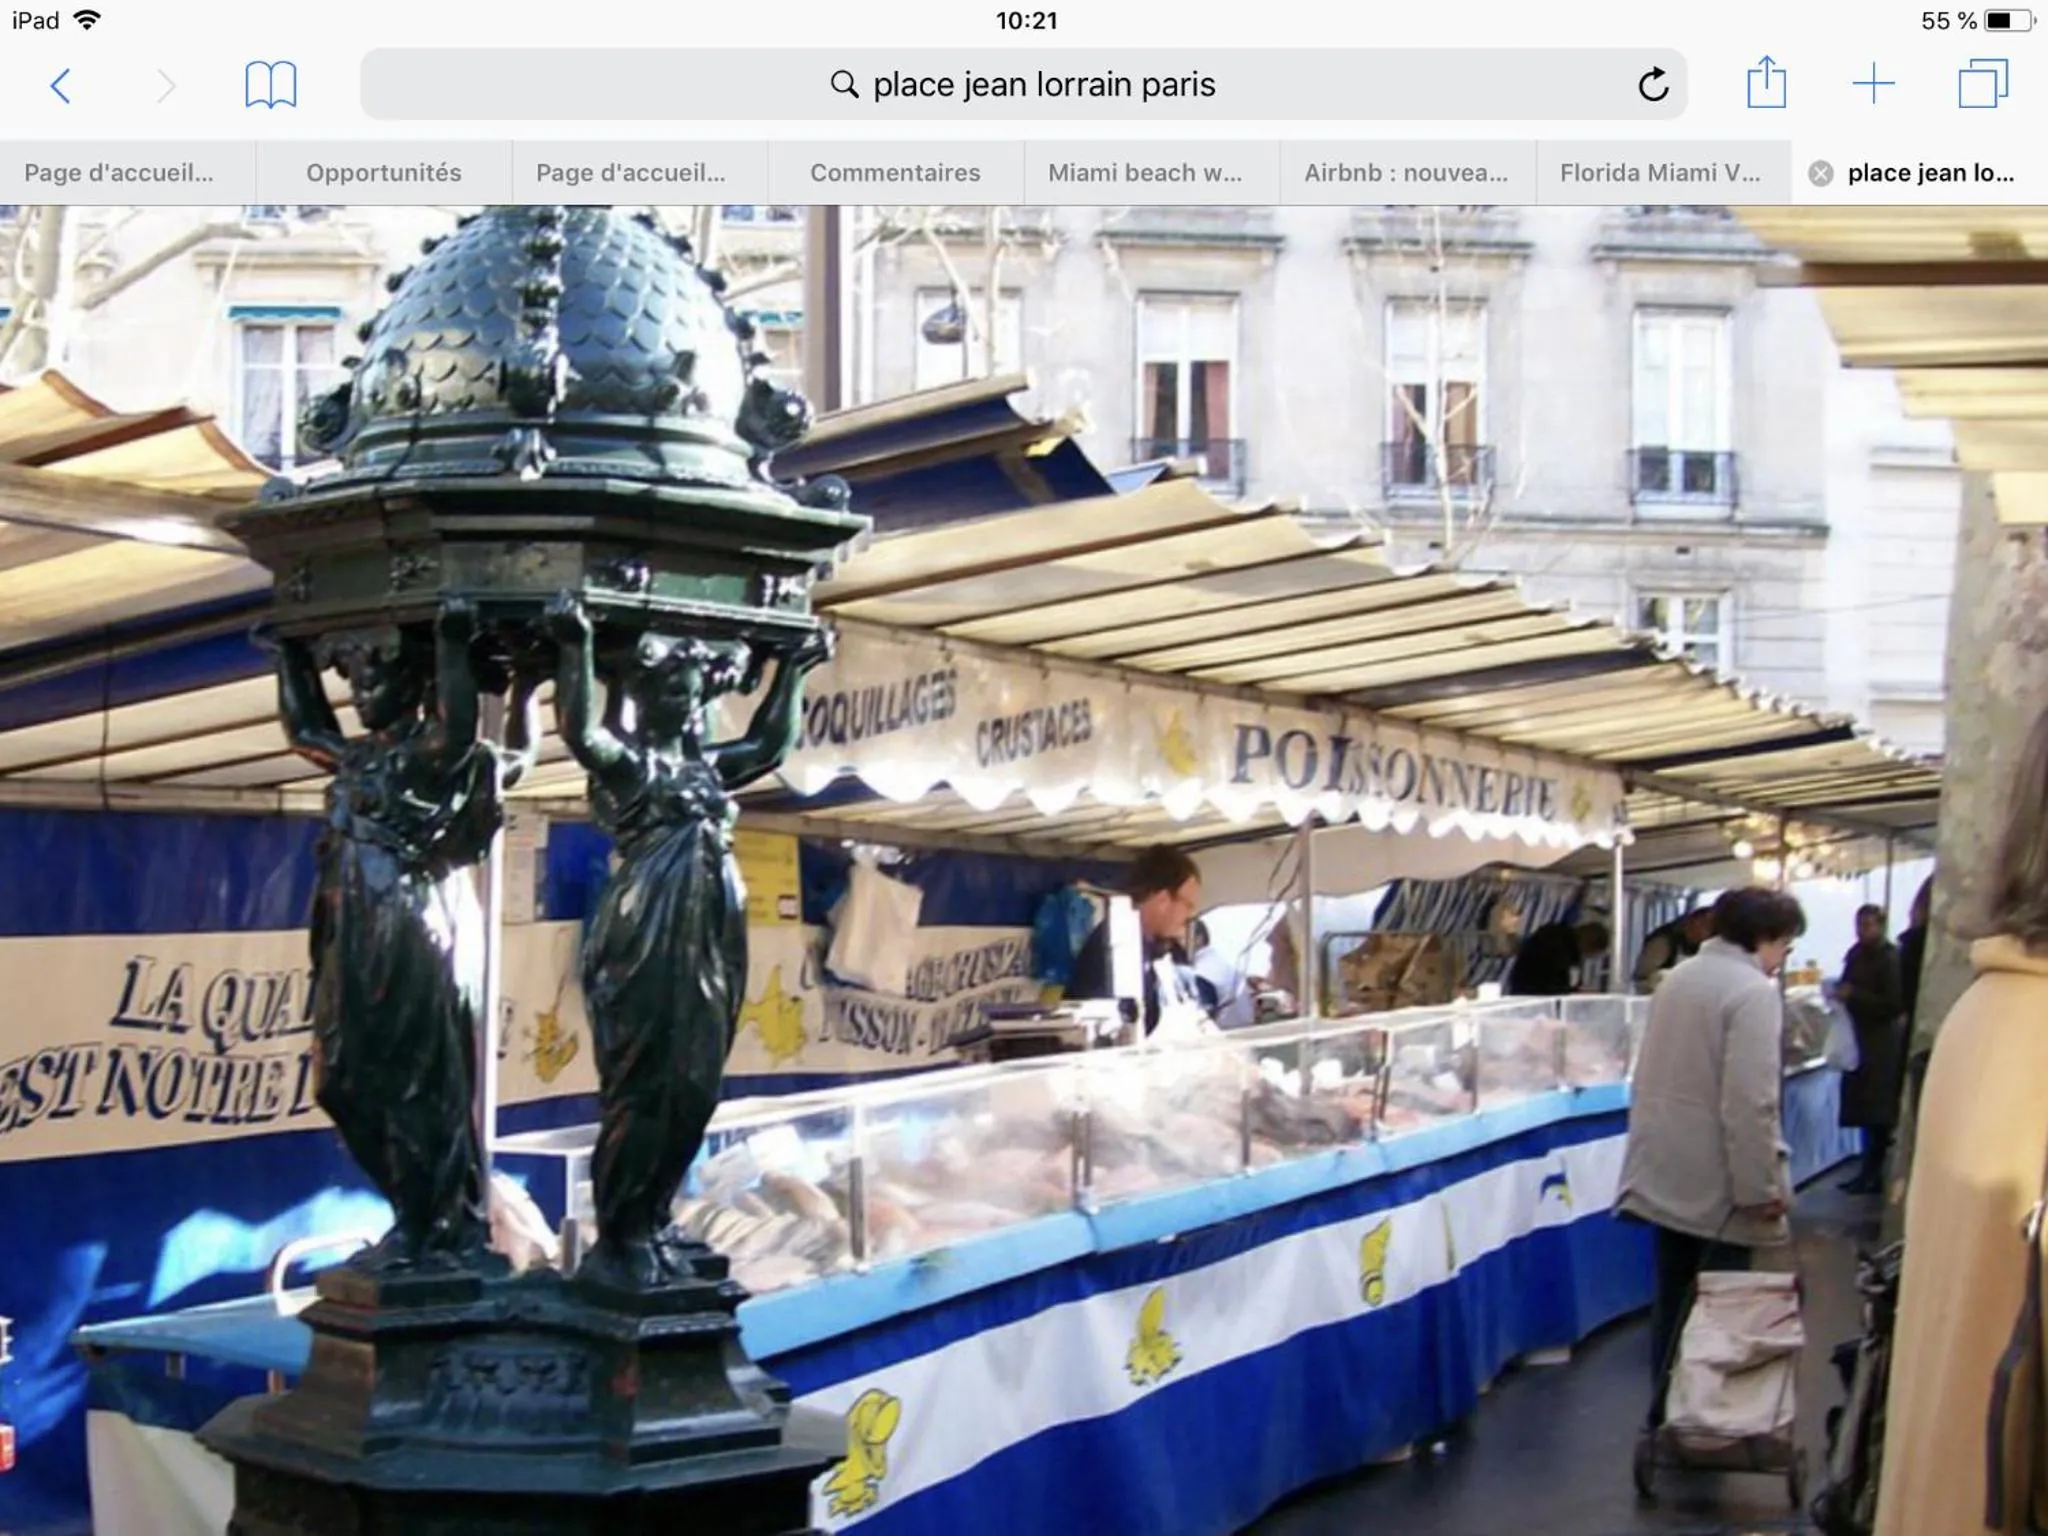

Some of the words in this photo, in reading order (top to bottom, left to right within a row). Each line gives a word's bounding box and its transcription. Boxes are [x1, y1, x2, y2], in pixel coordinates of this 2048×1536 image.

[12, 10, 60, 31] iPad
[995, 10, 1057, 31] 10:21
[1921, 11, 1951, 31] 55
[1957, 10, 1978, 31] %
[874, 70, 955, 104] place
[962, 69, 1027, 104] jean
[1037, 69, 1132, 98] lorrain
[1142, 69, 1217, 104] paris
[25, 163, 82, 187] Page
[89, 162, 213, 183] d'accueil...
[306, 161, 462, 187] Opportunités
[537, 163, 594, 187] Page
[601, 161, 726, 183] d'accueil...
[810, 162, 981, 183] Commentaires
[1049, 162, 1118, 183] Miami
[1125, 162, 1196, 183] beach
[1203, 167, 1242, 182] w...
[1304, 162, 1383, 182] Airbnb
[1404, 167, 1508, 183] nouvea...
[1561, 162, 1640, 183] Florida
[1648, 162, 1717, 183] Miami
[1724, 163, 1761, 182] V...
[1848, 161, 1912, 187] place
[1916, 161, 1967, 187] jean
[1973, 161, 2015, 183] lo...
[976, 696, 1092, 769] CRUSTACES
[110, 954, 195, 1034] LA
[202, 967, 314, 1056] QUA
[96, 1042, 283, 1126] NOTRE
